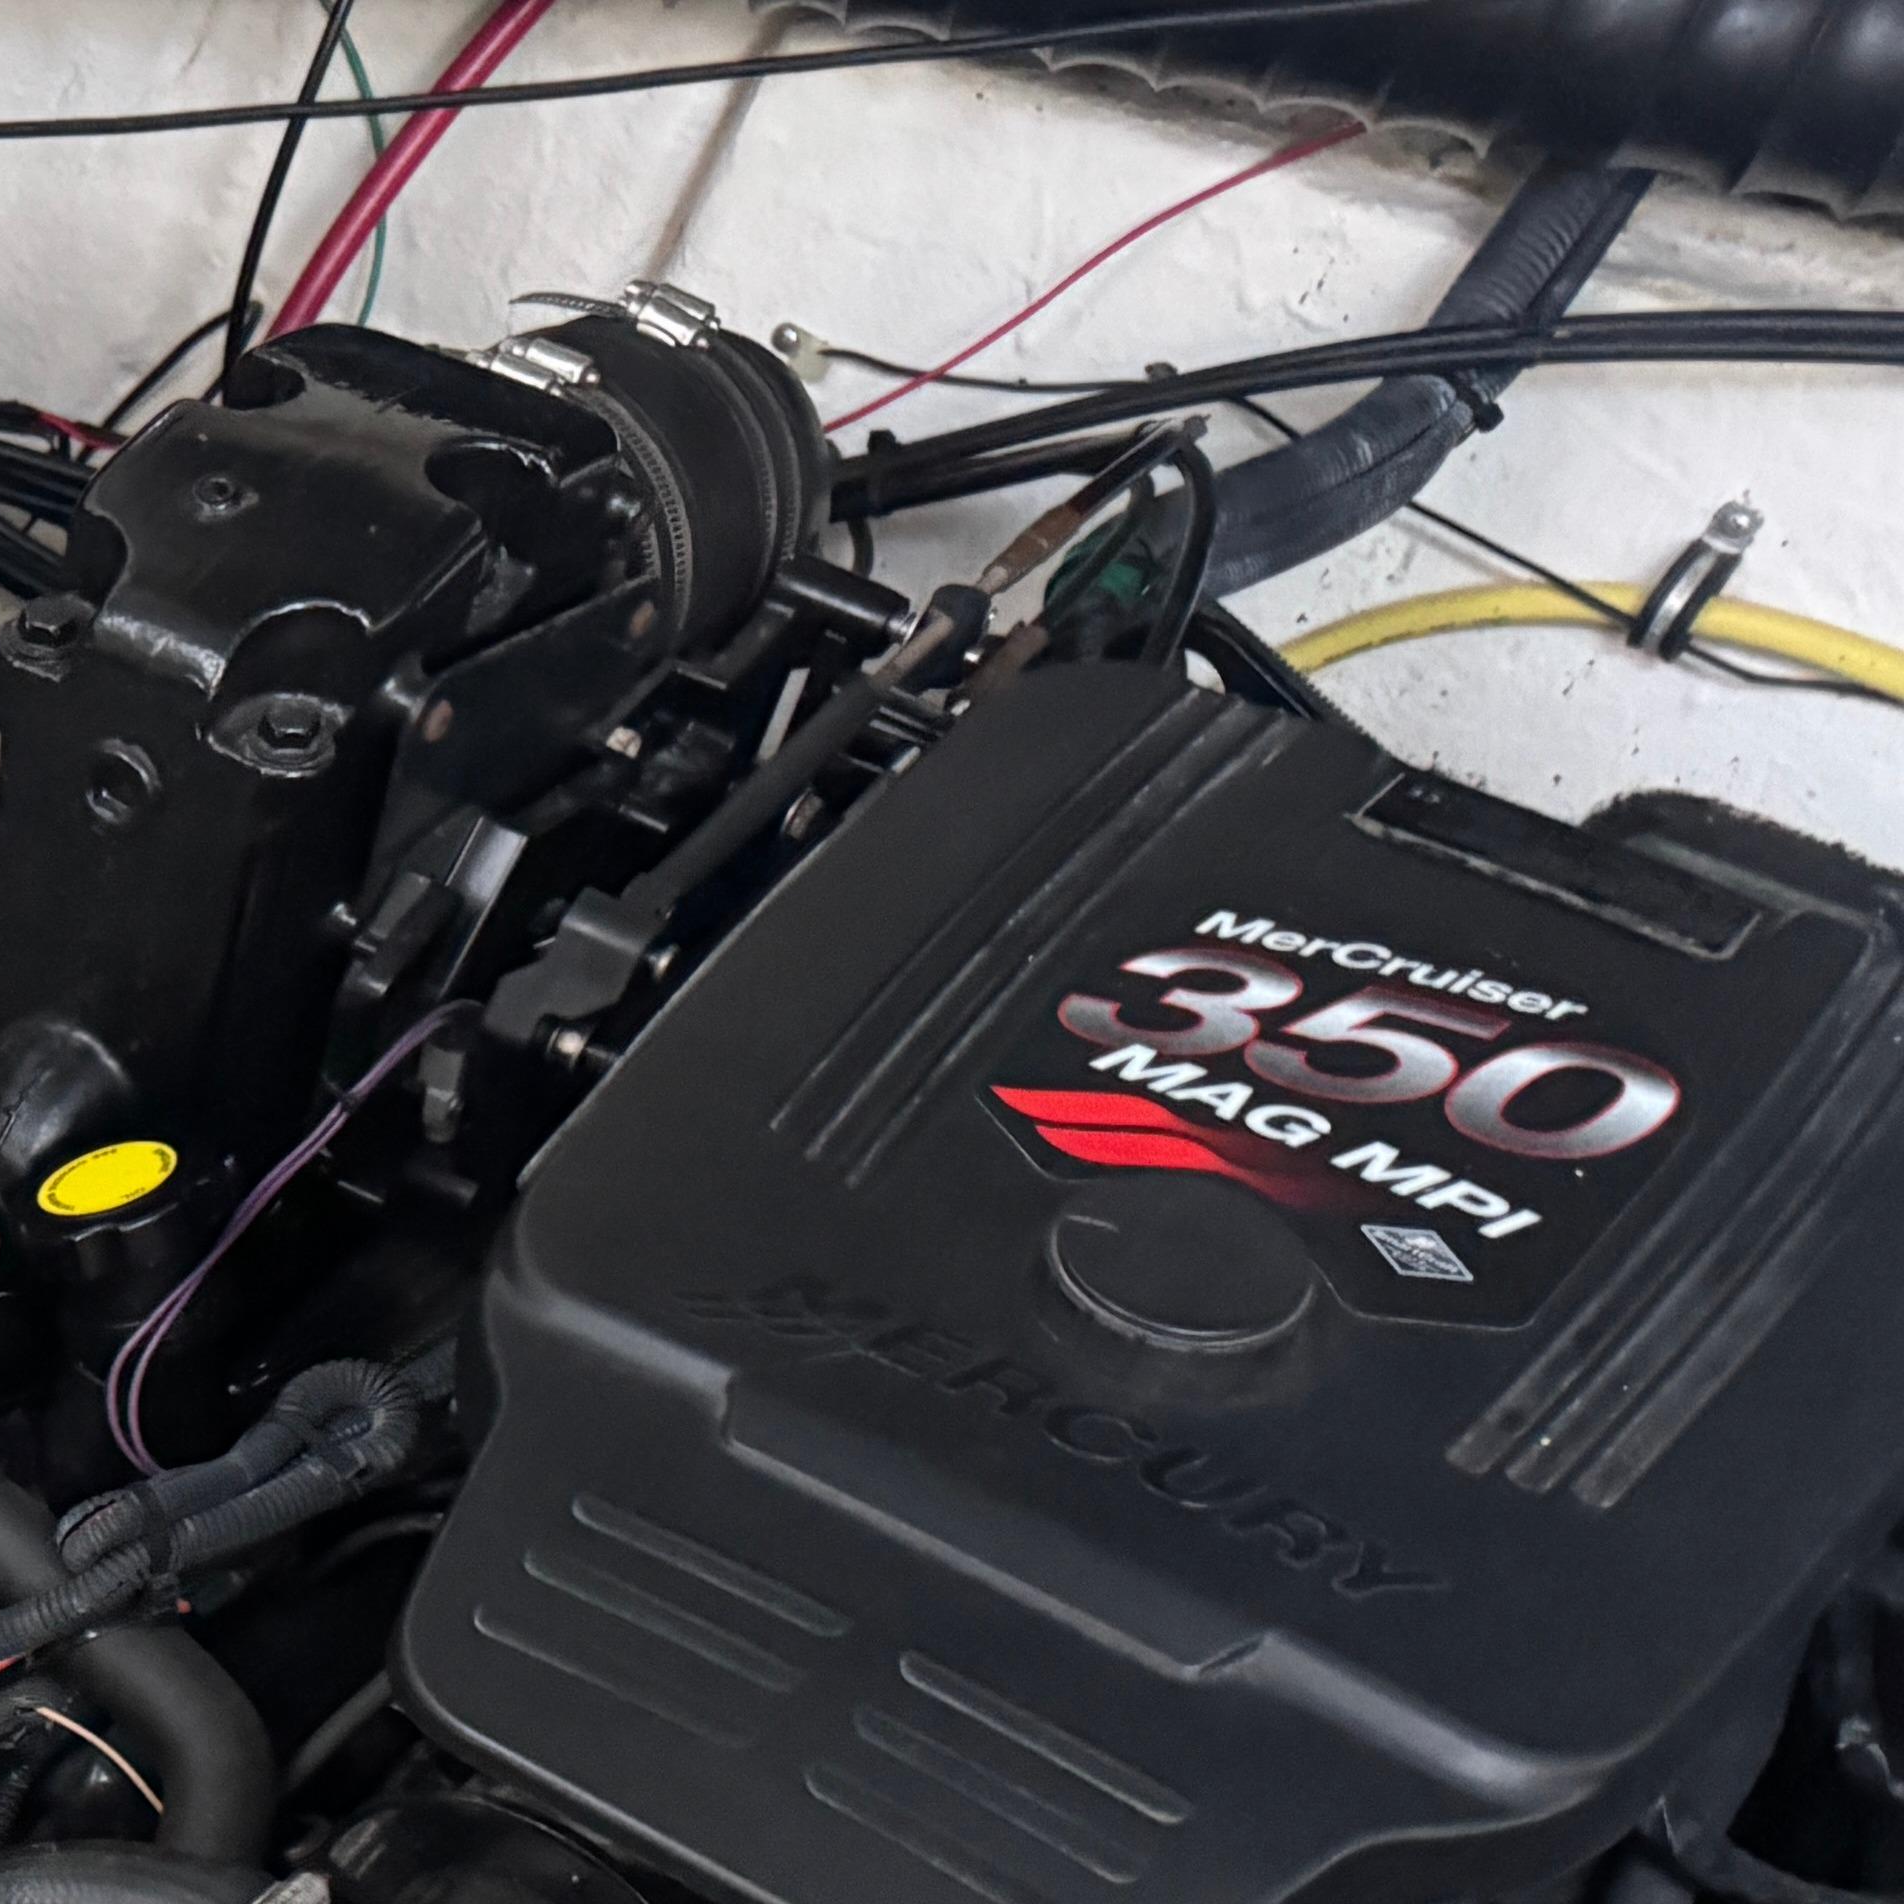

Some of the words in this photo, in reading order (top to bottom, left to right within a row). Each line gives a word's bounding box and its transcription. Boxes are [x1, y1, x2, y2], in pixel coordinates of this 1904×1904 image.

[1057, 947, 1680, 1159] 350
[1195, 910, 1590, 1021] MerCruiser
[1089, 1044, 1332, 1147] MAG
[1331, 1141, 1542, 1238] MPI
[675, 1275, 1450, 1598] MERCURY
